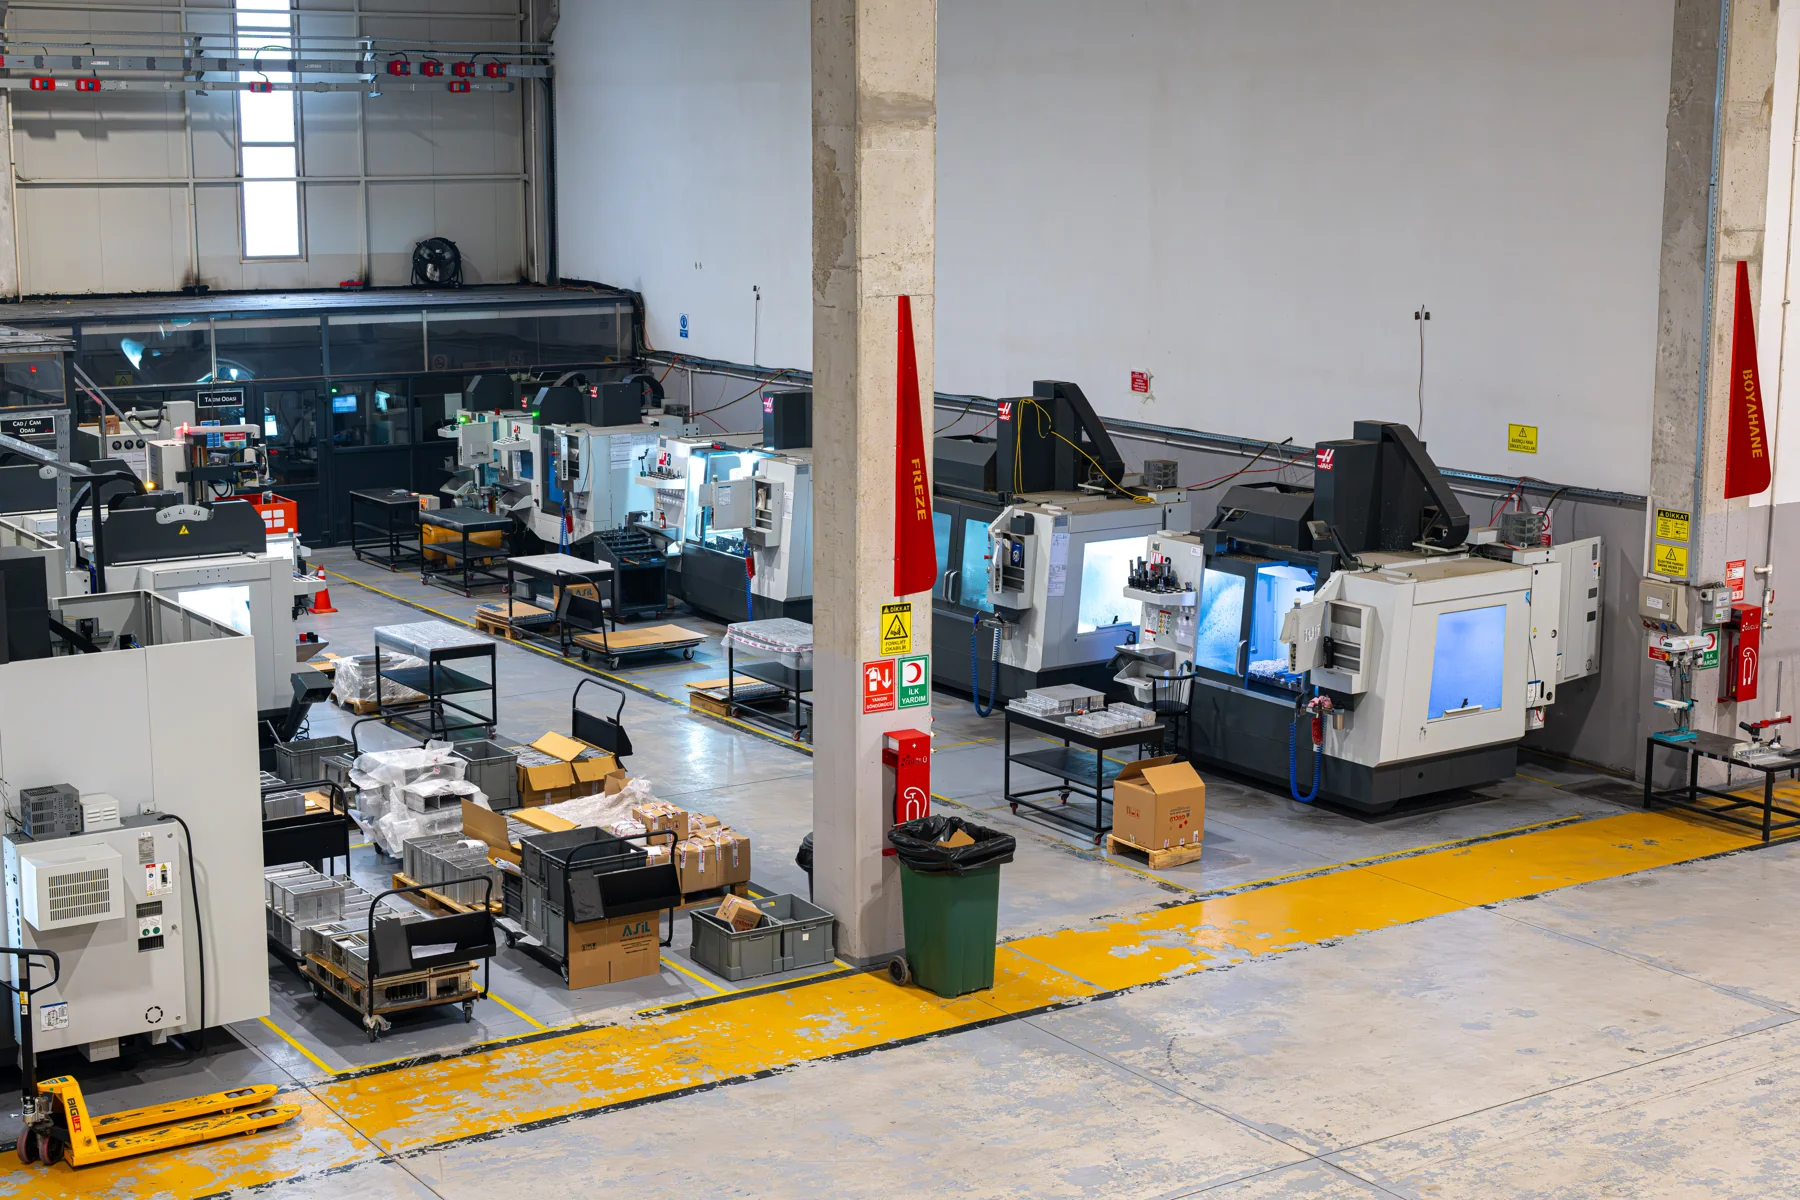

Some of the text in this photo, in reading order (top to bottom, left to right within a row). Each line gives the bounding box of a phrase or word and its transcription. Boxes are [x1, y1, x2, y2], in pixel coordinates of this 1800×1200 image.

[1742, 369, 1763, 458] BOYAHANE
[911, 458, 927, 521] FREZE
[1665, 510, 1688, 520] DİKKAT
[889, 605, 910, 613] DİKKAT
[908, 687, 919, 695] İLK
[902, 696, 926, 704] YARDIM
